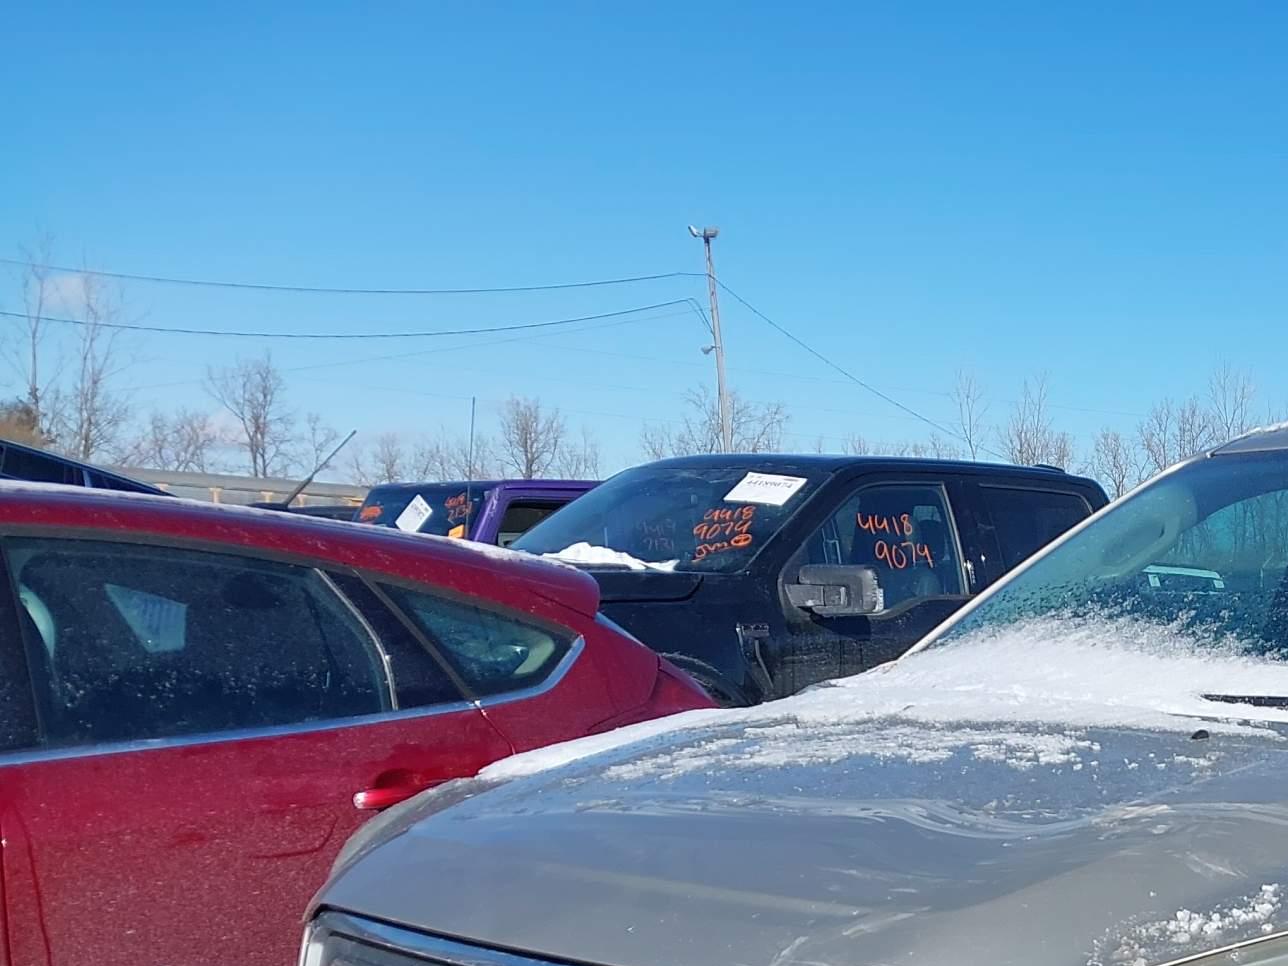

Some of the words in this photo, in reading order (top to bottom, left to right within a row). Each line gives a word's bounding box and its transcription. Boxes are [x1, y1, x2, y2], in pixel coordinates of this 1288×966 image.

[703, 505, 756, 521] 4418
[693, 520, 752, 539] 9074
[857, 512, 913, 536] 4418
[875, 540, 934, 569] 9074
